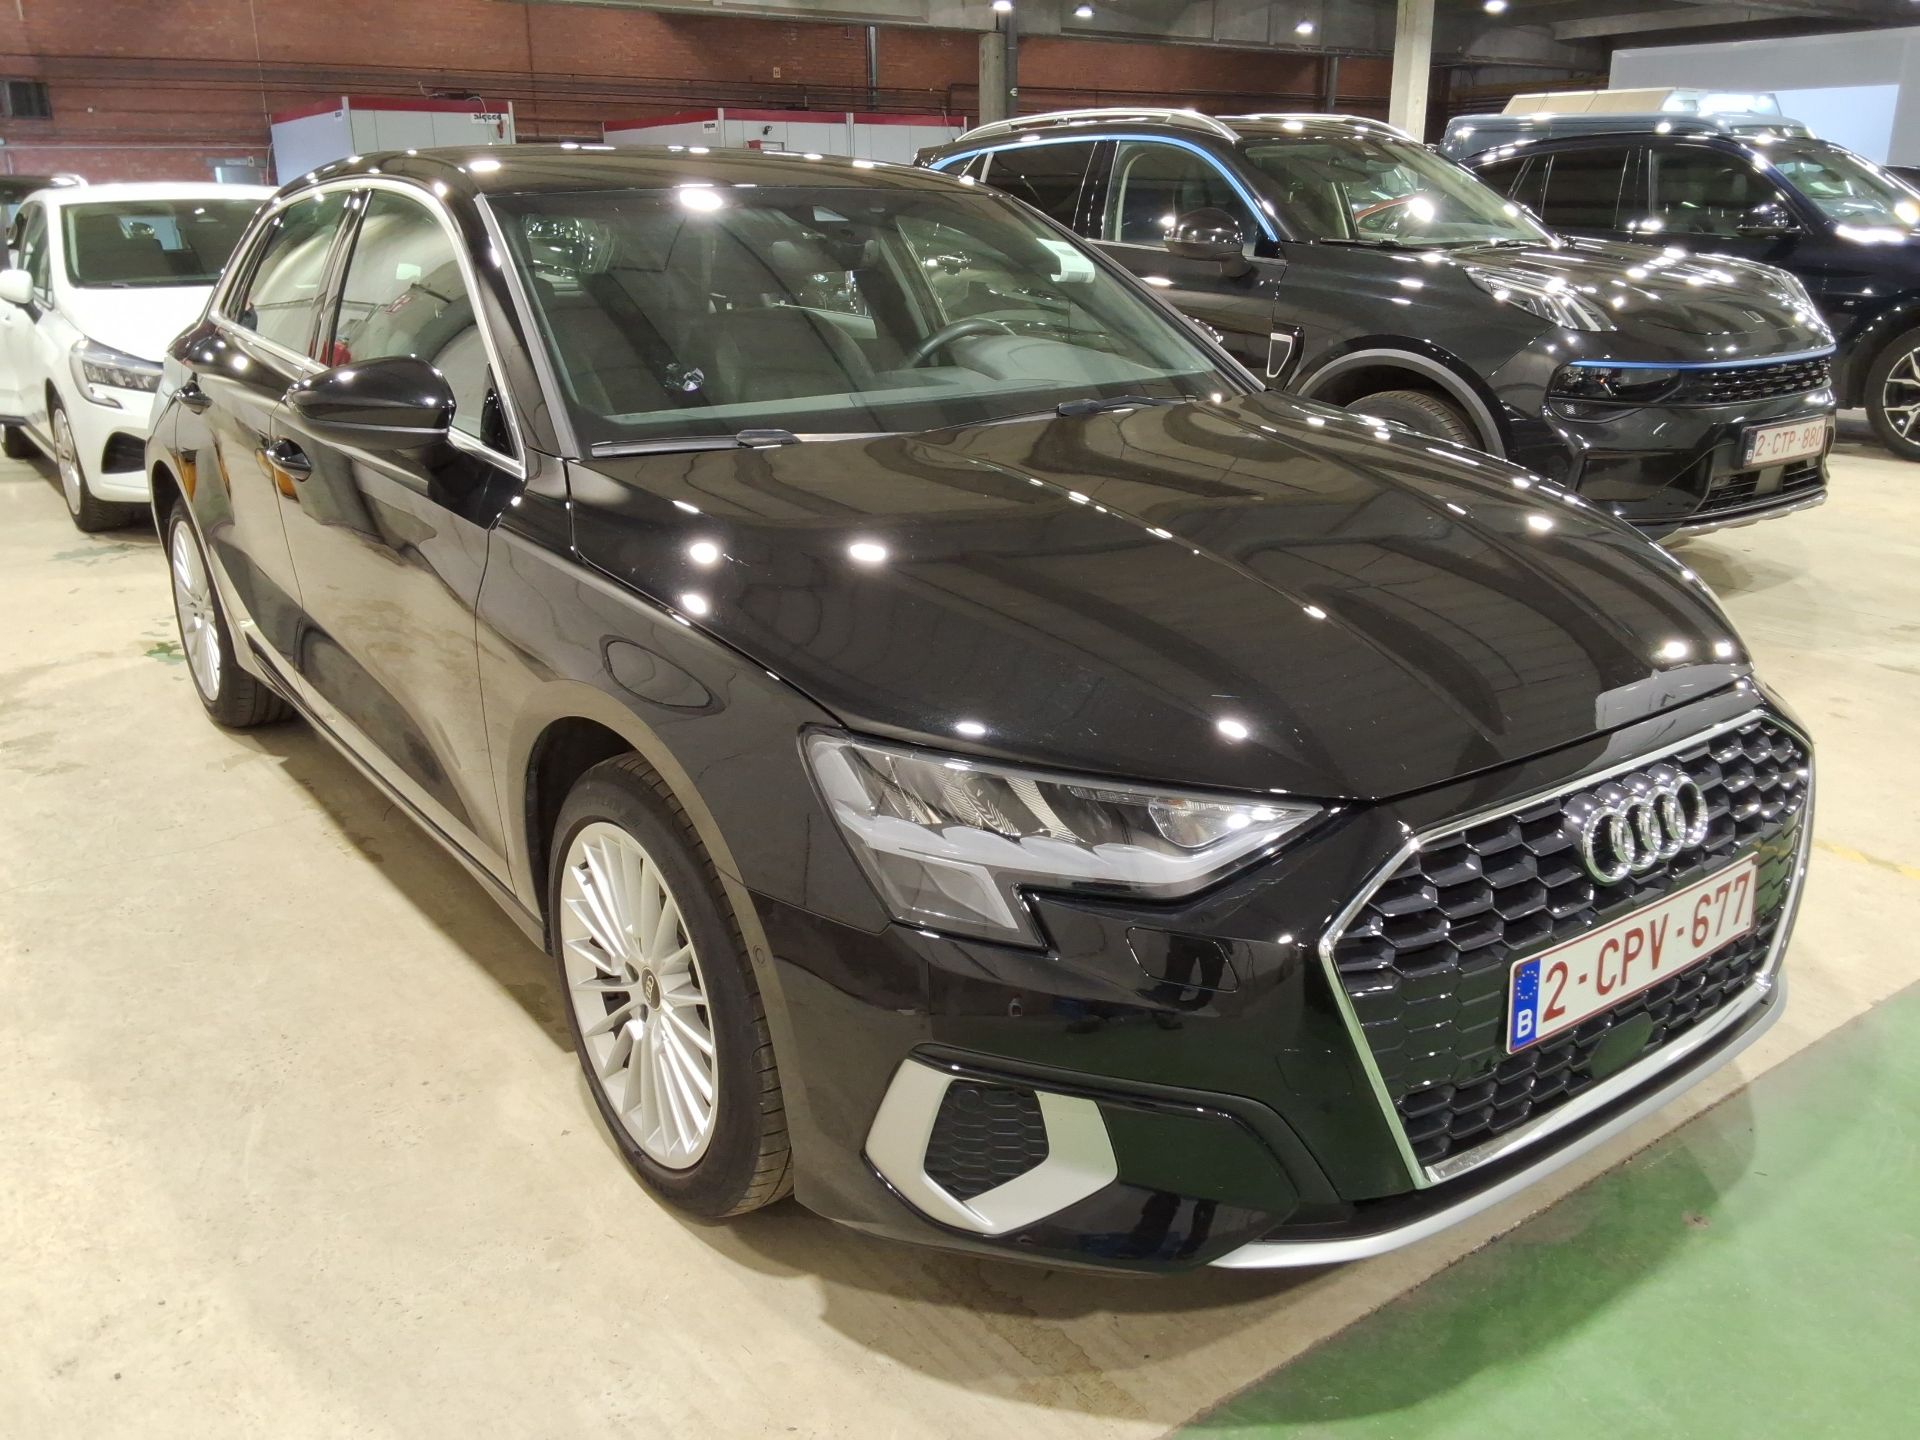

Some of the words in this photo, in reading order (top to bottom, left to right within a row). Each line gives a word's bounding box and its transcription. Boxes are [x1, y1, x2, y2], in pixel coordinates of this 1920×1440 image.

[1746, 449, 1754, 460] B
[1542, 870, 1752, 1023] 2-CPV-677
[1516, 1008, 1533, 1039] B
